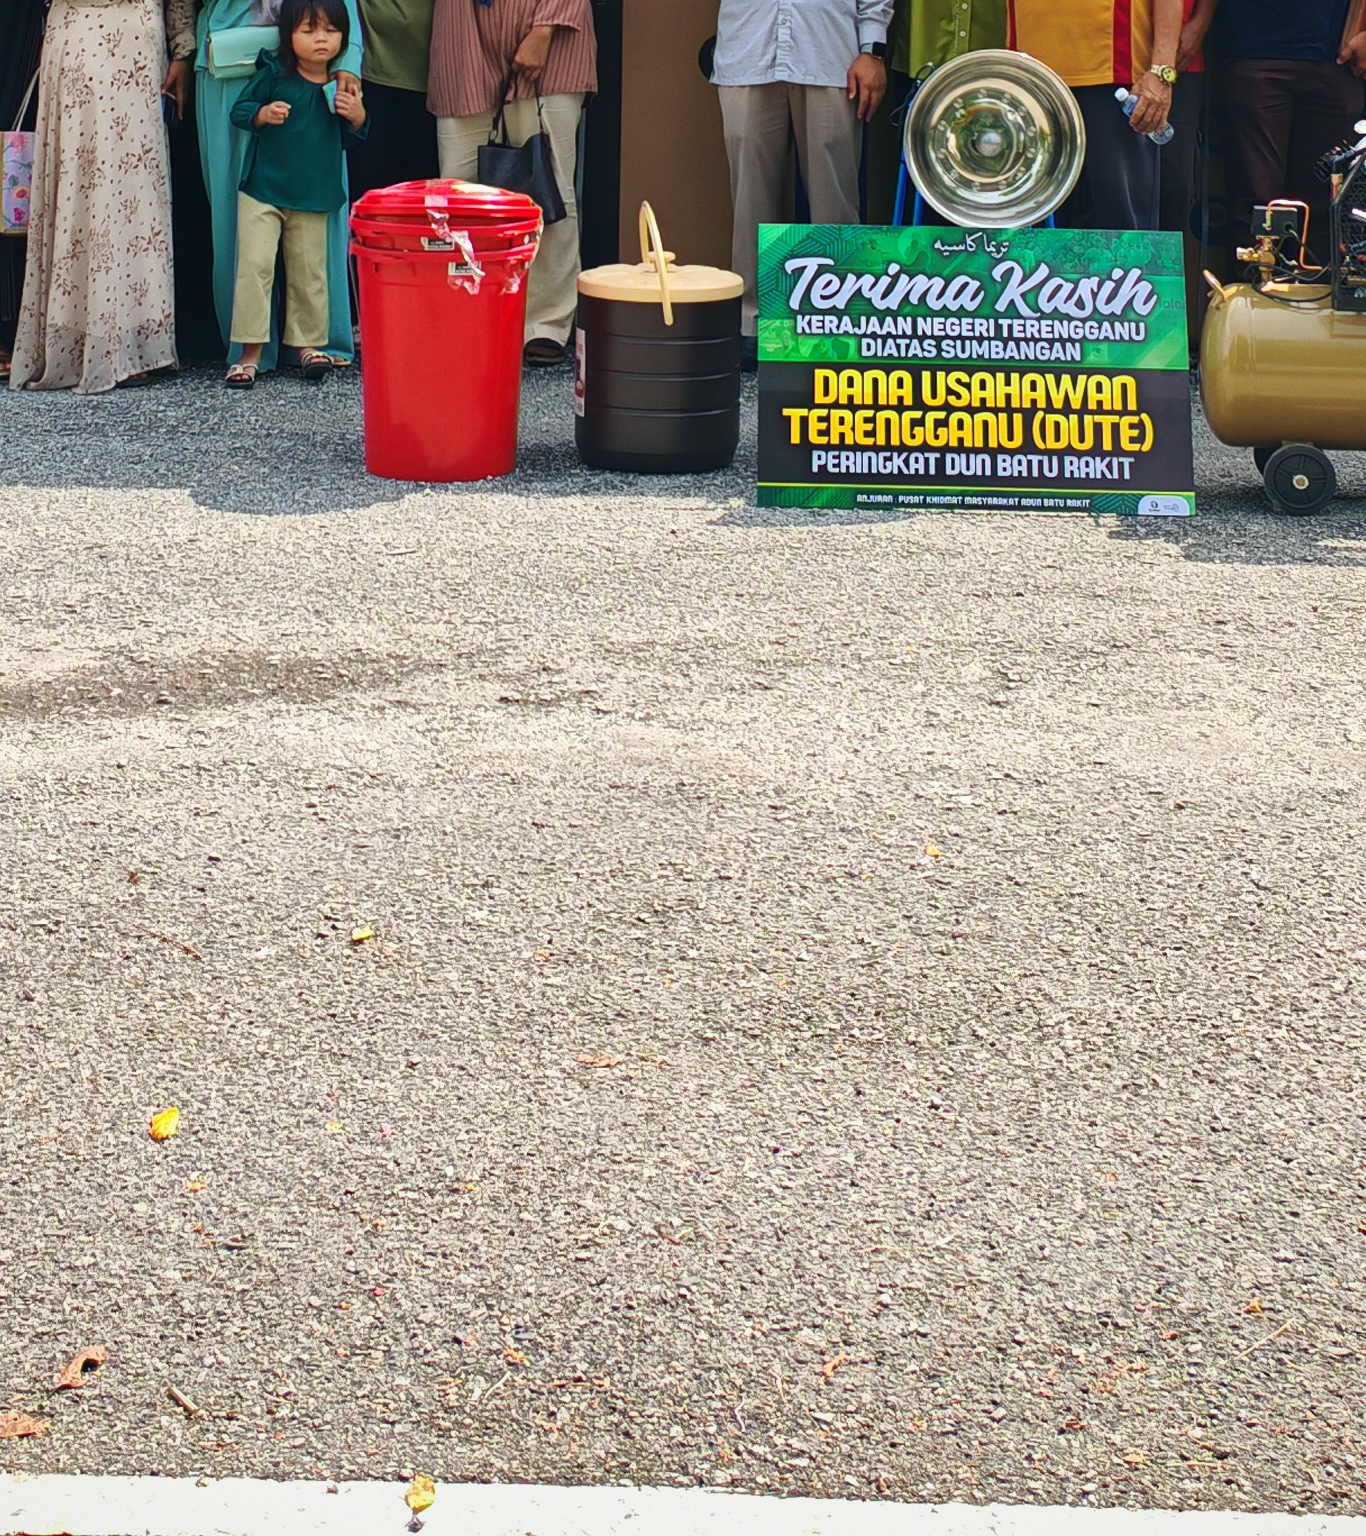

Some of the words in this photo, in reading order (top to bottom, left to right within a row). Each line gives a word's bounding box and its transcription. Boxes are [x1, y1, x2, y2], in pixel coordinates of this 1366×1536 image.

[784, 257, 985, 312] Terima
[991, 260, 1159, 318] Kasih
[796, 314, 912, 336] KERAJAAN
[916, 317, 996, 338] NEGERI
[998, 318, 1146, 342] TERENGGANU
[860, 338, 937, 358] DIATAS
[941, 340, 1082, 361] SUMBANGAN
[813, 368, 913, 407] DANA
[921, 371, 1137, 411] USAHAWAN
[782, 408, 1023, 449] TERENGGANU
[1032, 411, 1154, 453] (DUTE)
[811, 449, 941, 476] PERINGKAT
[945, 452, 993, 477] DUN
[996, 454, 1060, 478] BATU
[1063, 455, 1135, 480] RAKIT
[856, 493, 894, 503] ANJURAN
[898, 494, 924, 504] PUSAT
[926, 495, 963, 505] KHIDMAT
[964, 496, 1019, 506] MASYARAKAT
[1020, 497, 1042, 507] ADUN
[1043, 498, 1065, 507] BATU
[1066, 498, 1091, 508] RAKIT
